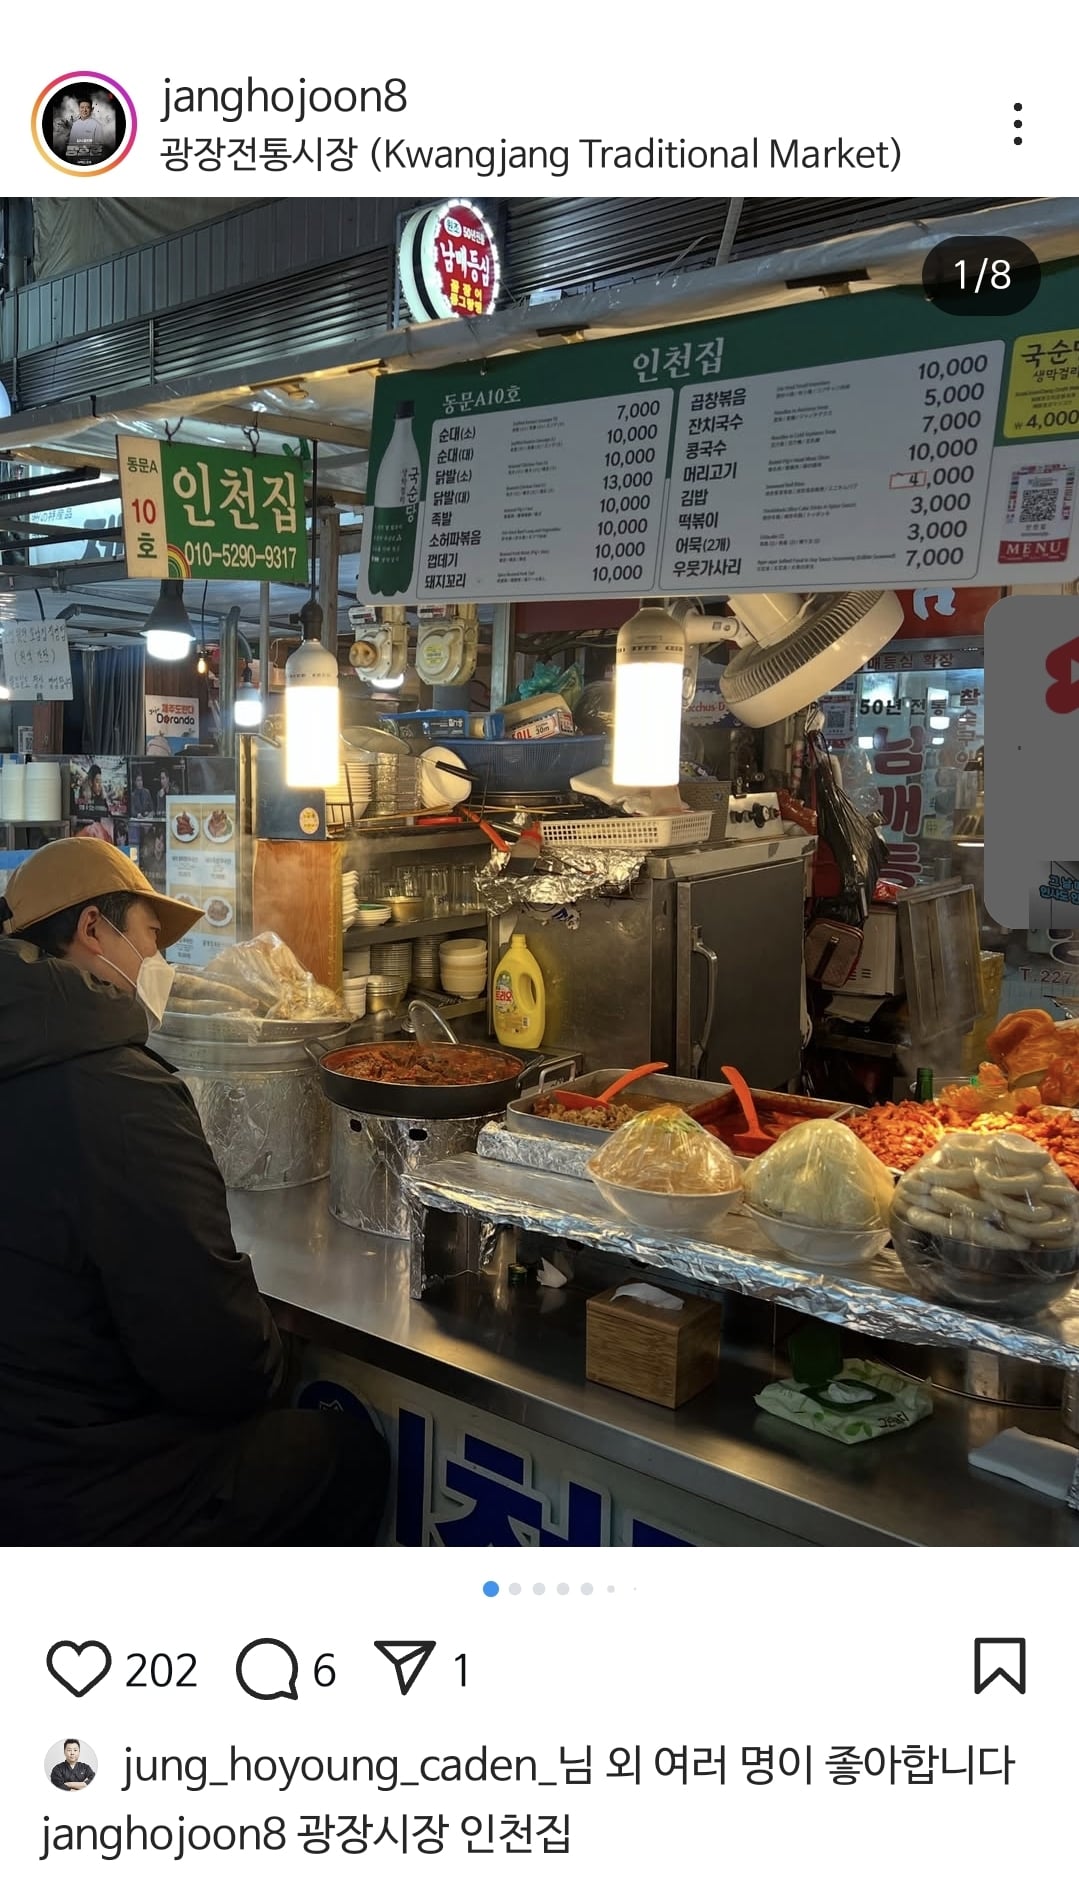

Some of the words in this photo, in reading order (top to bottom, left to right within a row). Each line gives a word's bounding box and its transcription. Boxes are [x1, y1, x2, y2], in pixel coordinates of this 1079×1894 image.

[632, 336, 726, 384] 인천집
[690, 388, 747, 411] 곱창볶음
[918, 355, 988, 381] 10,000
[442, 385, 521, 414] 동문A10호
[688, 415, 744, 435] 잔치국수
[924, 383, 984, 410] 5,000
[439, 427, 476, 444] 순대(소)
[616, 400, 660, 422] 7,000
[1026, 409, 1079, 429] 4,000
[437, 448, 474, 465] 순대(대)
[607, 424, 657, 445] 10,000
[685, 440, 727, 460] 콩국수
[922, 411, 981, 437] 7,000
[128, 456, 158, 473] 동문A
[435, 469, 472, 485] 닭발(소)
[604, 448, 655, 468] 10,000
[683, 463, 737, 483] 머리고기
[907, 438, 978, 464] 10,000
[173, 462, 297, 534] 인천집
[433, 490, 470, 507] 닭발(대)
[602, 471, 653, 491] 13,000
[681, 489, 708, 507] 김밥
[132, 498, 156, 525] 10
[431, 511, 452, 526] 족발
[599, 495, 650, 514] 10,000
[678, 513, 719, 530] 떡볶이
[910, 493, 971, 516] 3,000
[137, 532, 157, 559] 호
[429, 530, 481, 548] 소허파볶음
[597, 518, 648, 538] 10,000
[676, 537, 731, 554] 어묵(2개)
[907, 520, 968, 543] 3,000
[184, 541, 296, 569] 010-5290-9317
[427, 554, 458, 569] 껍데기
[594, 542, 645, 560] 10,000
[673, 559, 742, 578] 우뭇가사리
[906, 547, 964, 570] 7,000
[1006, 542, 1062, 556] MENU
[424, 574, 466, 590] 돼지꼬리
[592, 565, 643, 583] 10,000
[857, 654, 912, 670] 매등심
[924, 653, 953, 667] 확장
[860, 698, 902, 715] 50년
[911, 699, 946, 716] 전통
